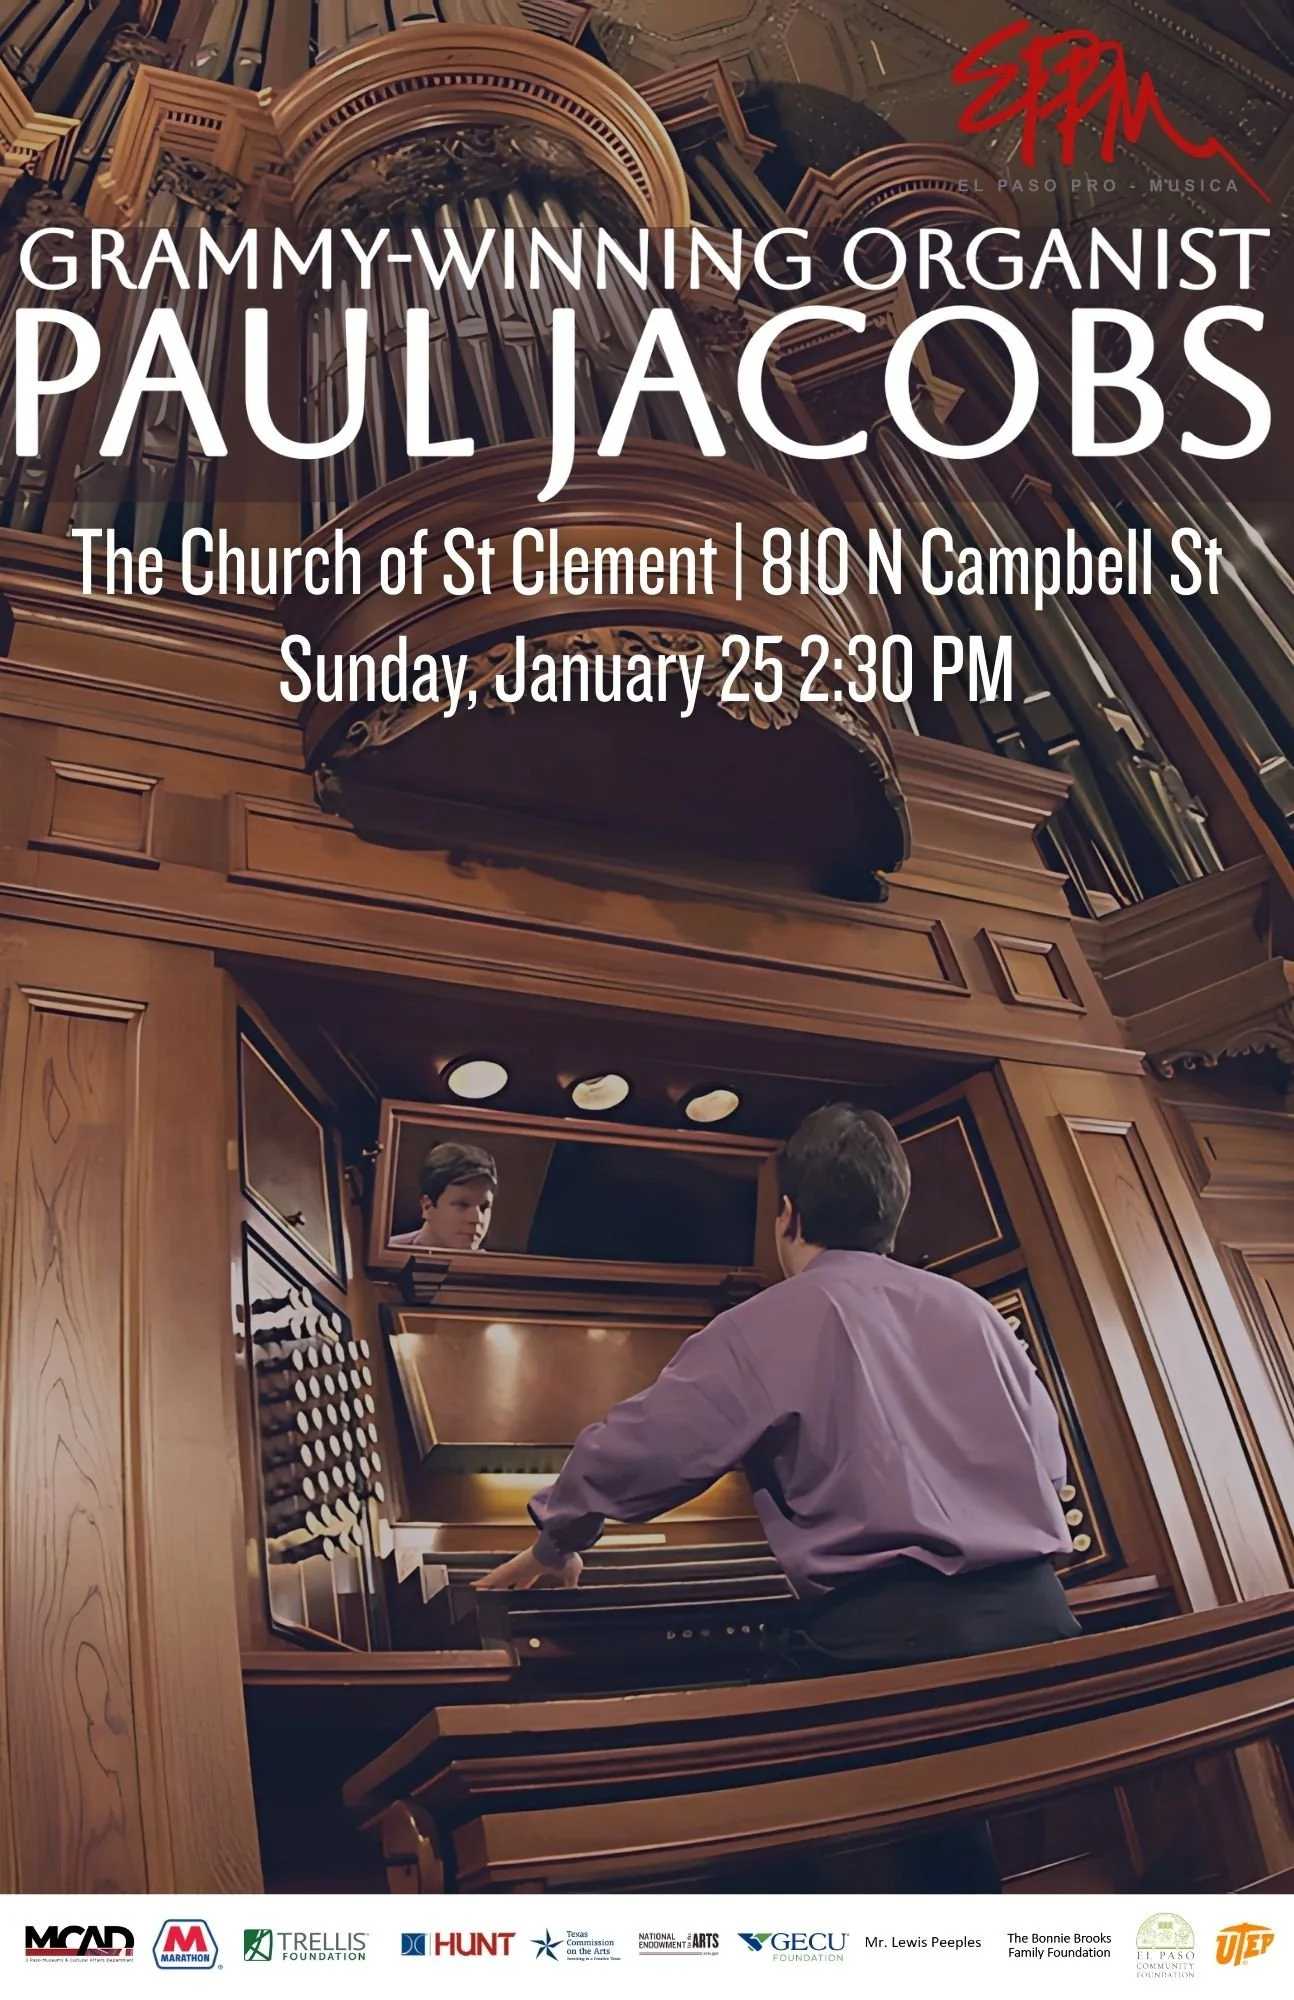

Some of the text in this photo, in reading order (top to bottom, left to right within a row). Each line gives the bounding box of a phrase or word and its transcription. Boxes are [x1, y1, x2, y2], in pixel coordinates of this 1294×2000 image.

[958, 179, 983, 192] EL
[998, 179, 1057, 192] PASO
[1071, 179, 1116, 192] PRO
[1150, 179, 1239, 192] MUSICA
[20, 227, 1271, 291] GRAMMY-WINNING ORGANIST
[15, 305, 1271, 503] PAUL JACOBS
[72, 528, 163, 596] The
[182, 527, 361, 596] Church
[380, 528, 428, 596] of
[443, 527, 495, 596] St
[512, 527, 718, 596] Clement
[762, 527, 849, 596] 810
[868, 528, 902, 595] N
[921, 527, 1152, 611] Campbell
[1170, 527, 1223, 596] St
[280, 634, 1012, 718] Sunday, January 25 2:30 PM
[25, 1925, 135, 1956] MCAD
[163, 1926, 208, 1952] M
[566, 1930, 588, 1938] Texas
[692, 1932, 719, 1949] ARTS
[1008, 1933, 1112, 1944] The Bonnie Brooks
[277, 1932, 366, 1951] TRELLIS
[435, 1932, 516, 1956] HUNT
[639, 1941, 686, 1949] ENDOWMENT
[770, 1933, 847, 1951] GECU
[865, 1936, 982, 1950] Mr. Lewis Peeples
[1216, 1922, 1275, 1966] UTEP
[161, 1954, 210, 1962] MARATHON
[282, 1952, 366, 1961] FOUNDATION
[772, 1954, 844, 1962] FOUNDATION
[1008, 1947, 1111, 1959] Family Foundation
[1137, 1951, 1195, 1960] EL PASO
[1136, 1962, 1194, 1970] COMMUNITY
[1136, 1971, 1195, 1979] FOUNDATION
